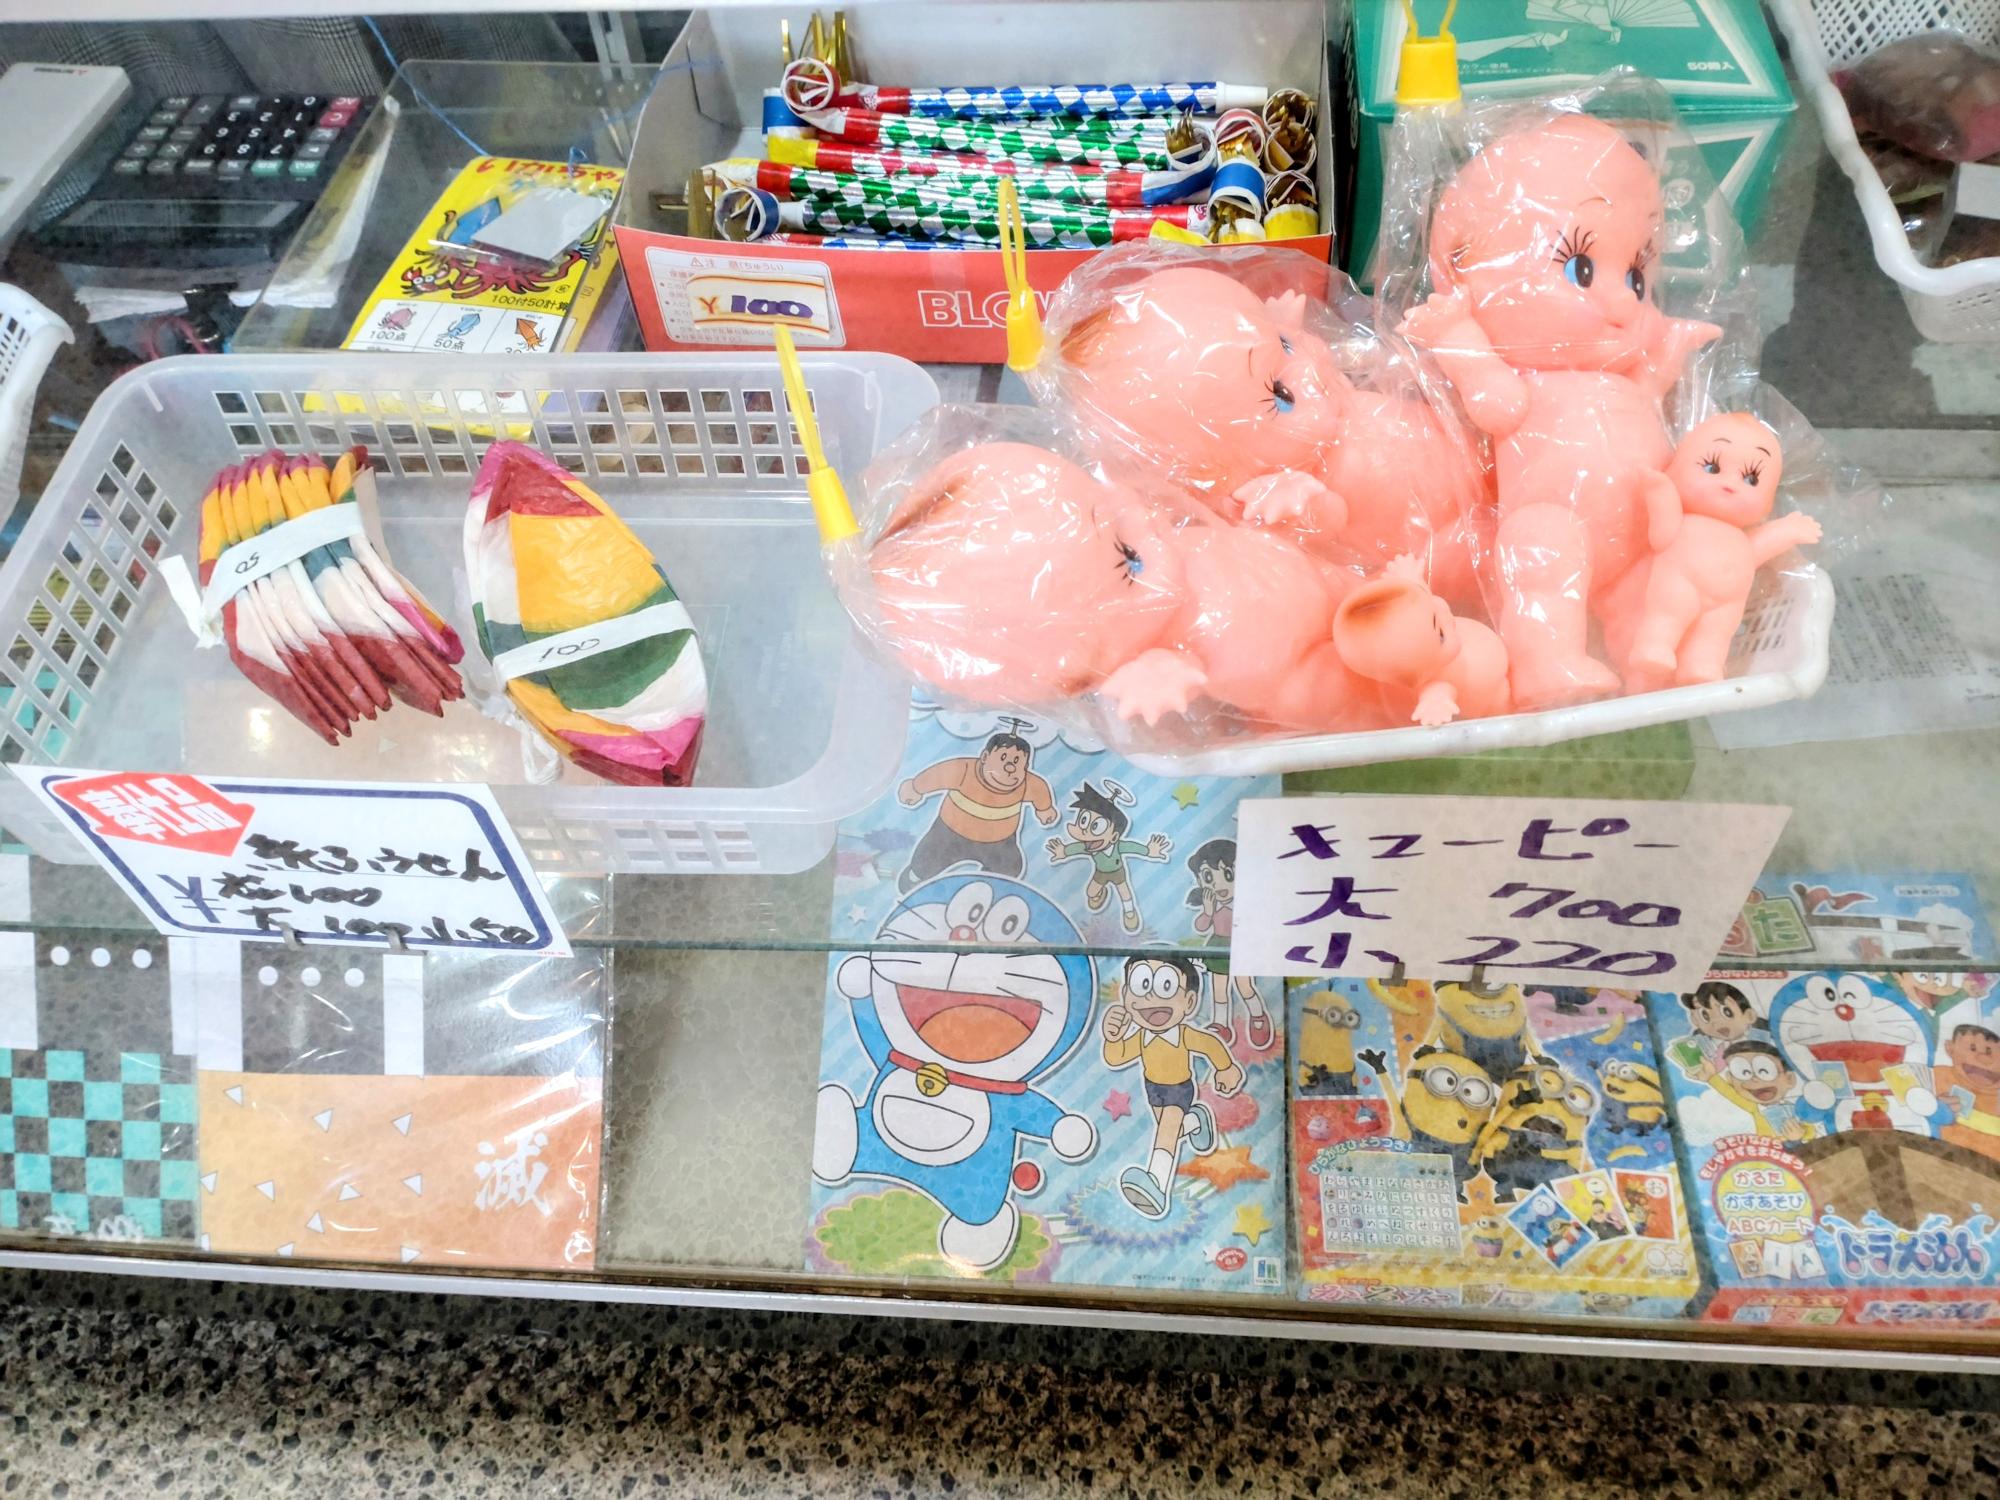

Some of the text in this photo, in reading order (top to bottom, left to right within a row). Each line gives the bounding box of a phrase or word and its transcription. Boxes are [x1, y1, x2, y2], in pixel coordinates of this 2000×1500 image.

[538, 638, 601, 662] 100
[76, 777, 243, 840] 奉仕品
[1282, 876, 1682, 928] 大 700
[1283, 931, 1678, 978] 小 220
